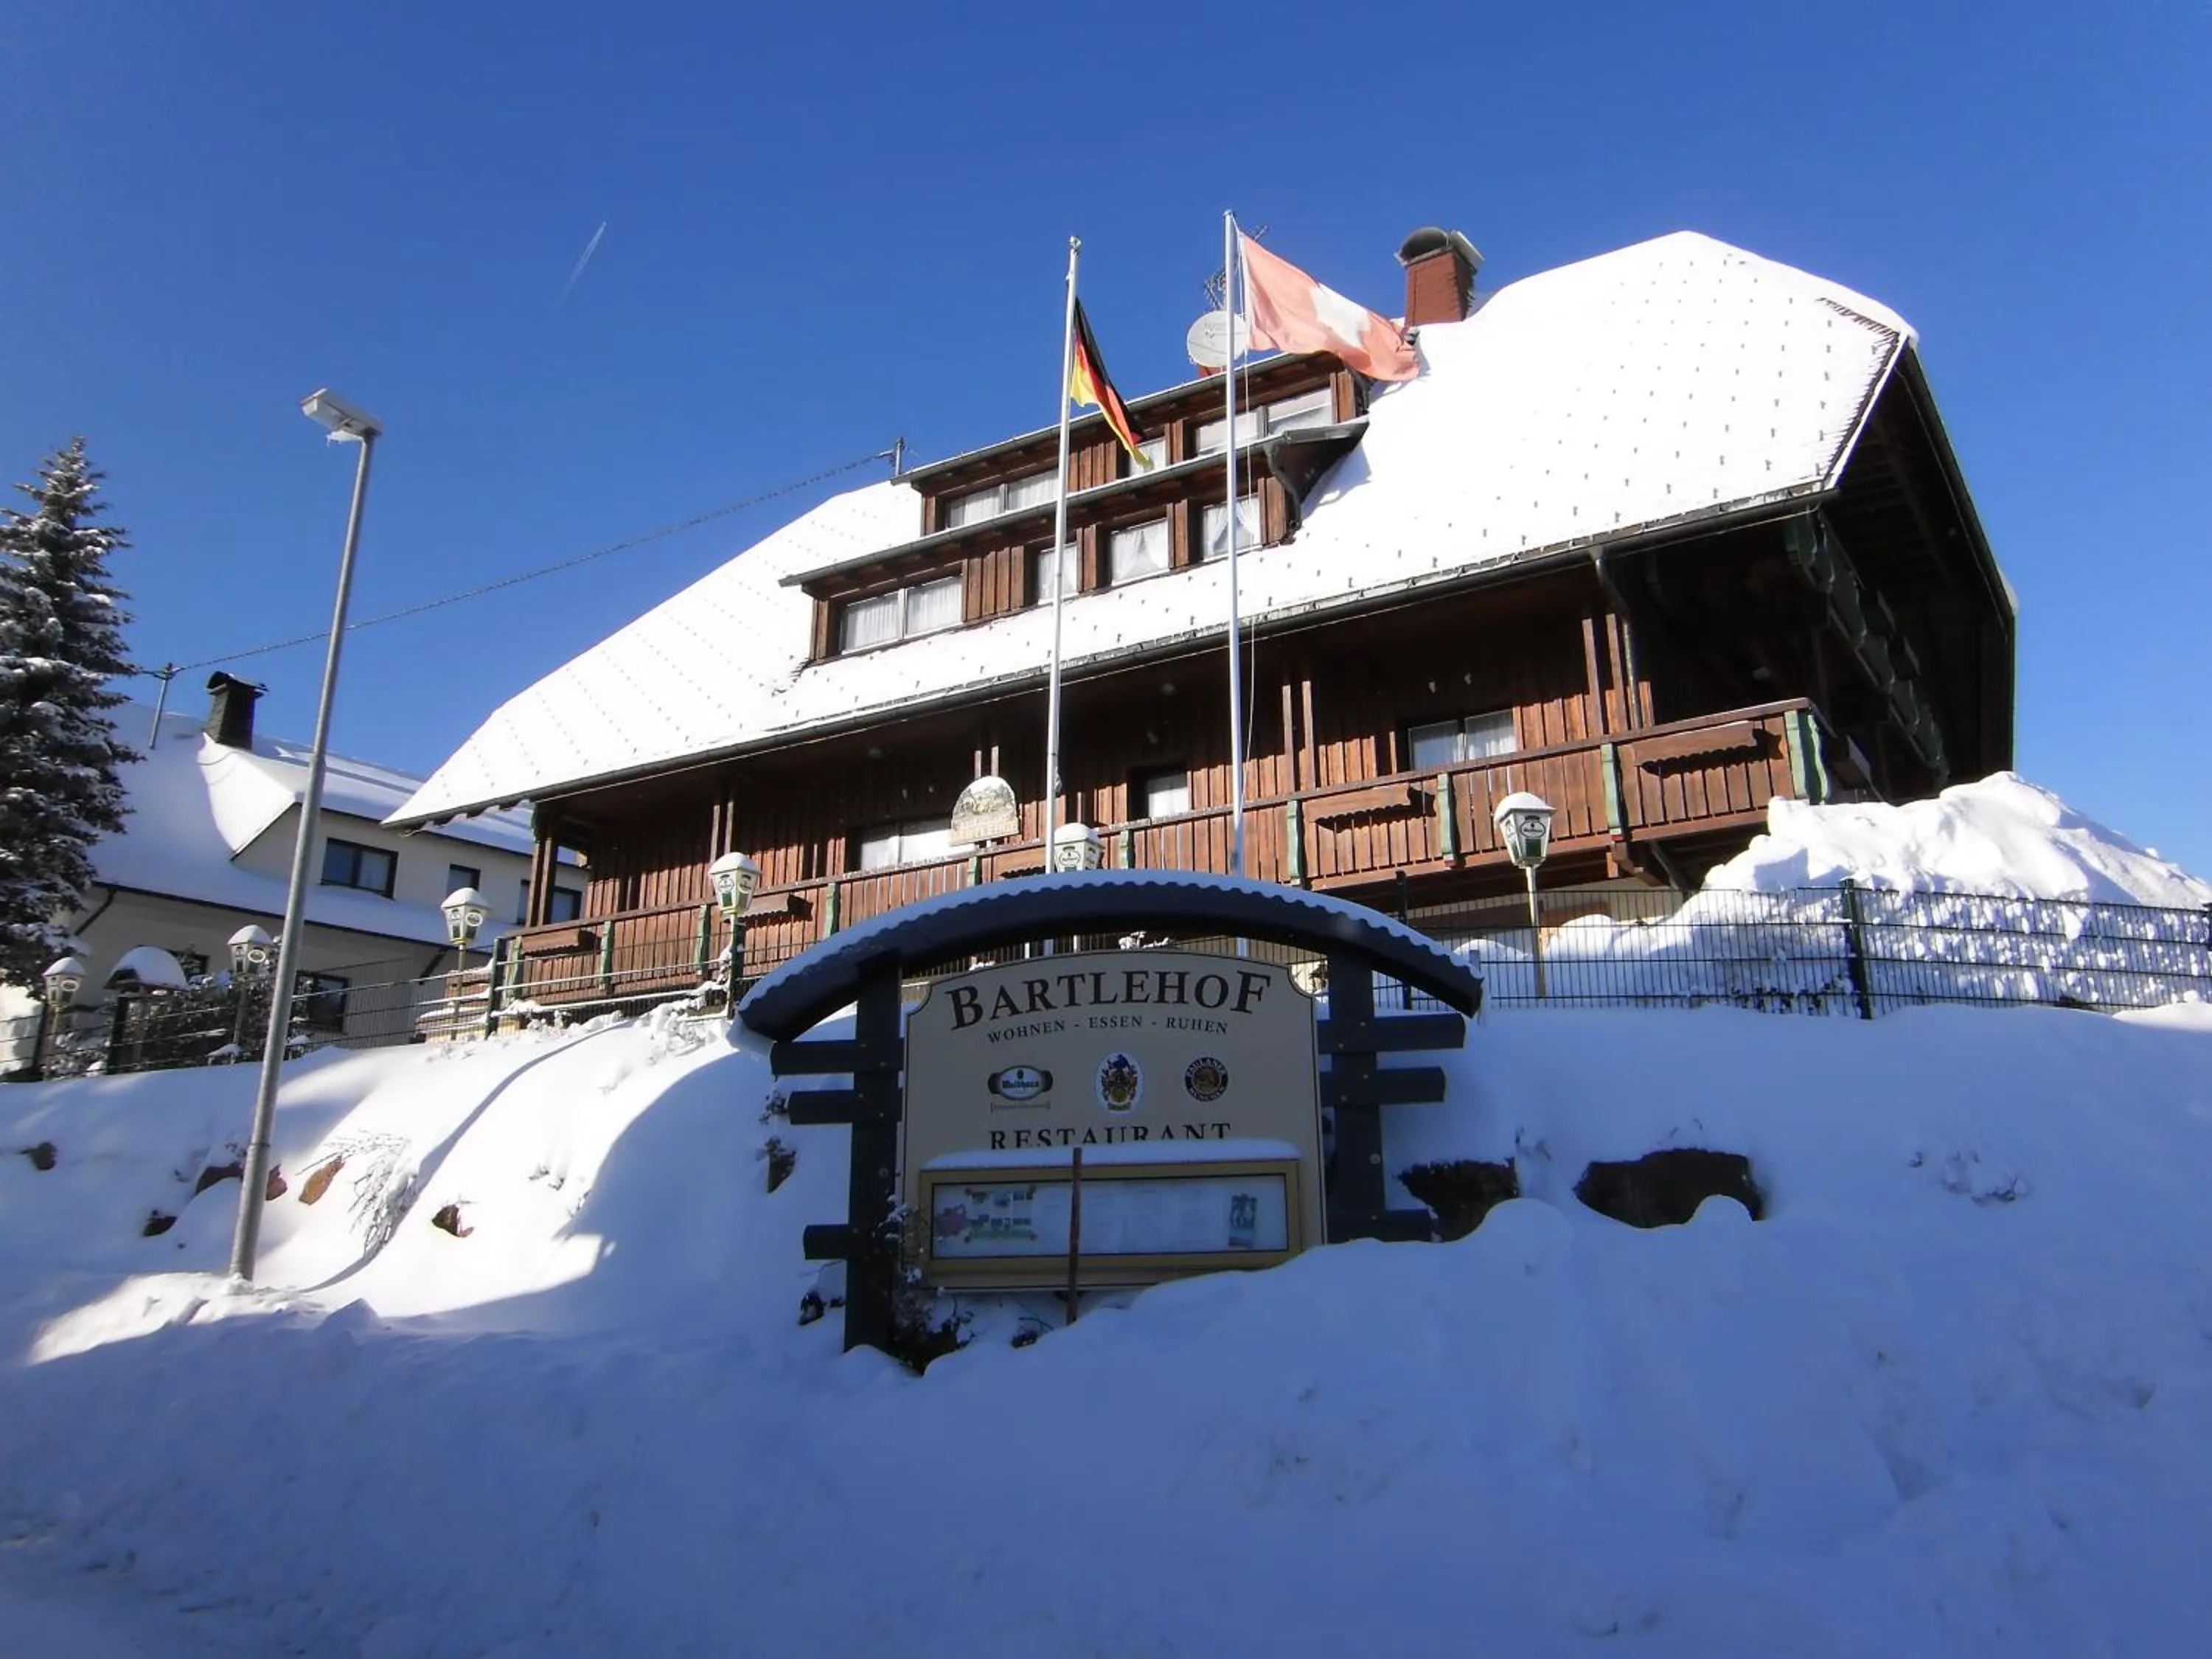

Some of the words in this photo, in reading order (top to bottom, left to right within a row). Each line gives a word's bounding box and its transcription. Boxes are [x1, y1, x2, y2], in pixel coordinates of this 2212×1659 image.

[945, 970, 1271, 1031] BARTLEHOF
[987, 1019, 1065, 1044] WOHNEN
[1089, 1015, 1143, 1029] ESSEN
[1166, 1016, 1228, 1034] RUHEN
[989, 1122, 1231, 1151] RESTAURANT
